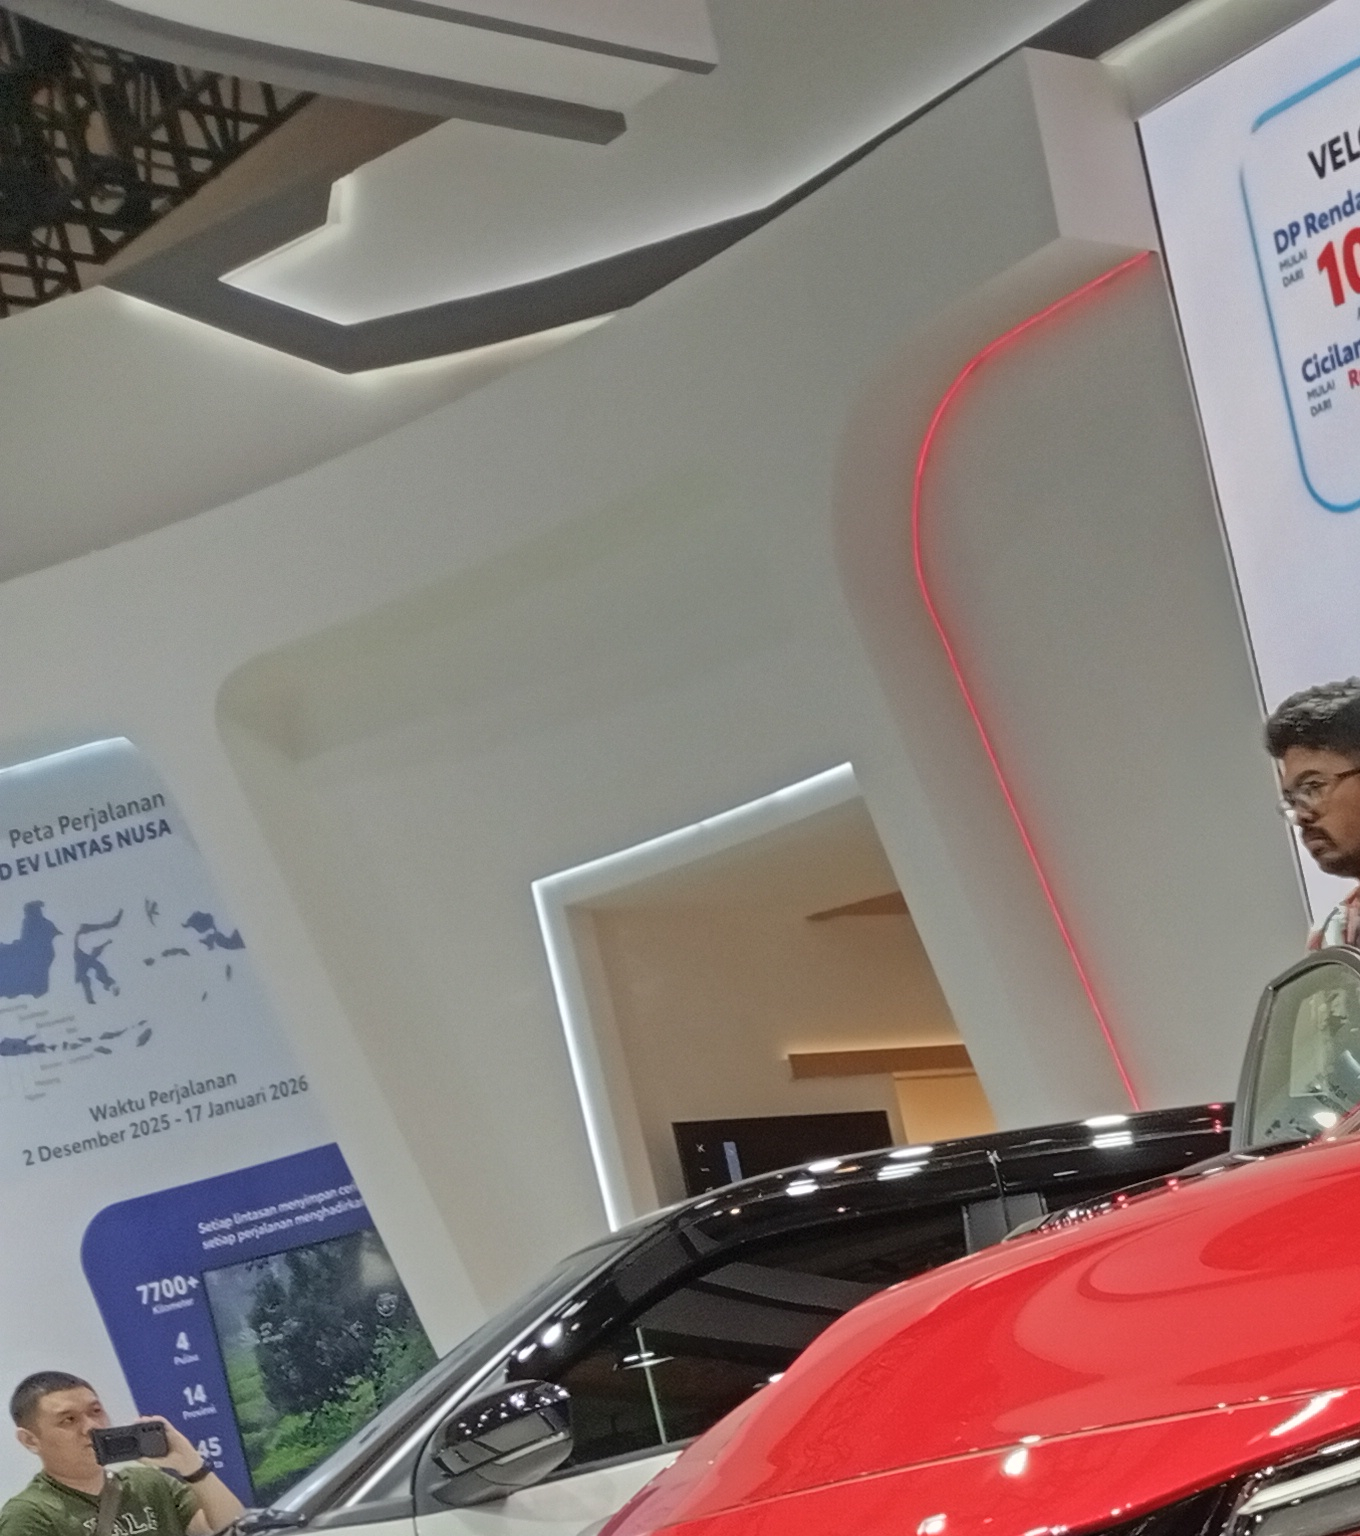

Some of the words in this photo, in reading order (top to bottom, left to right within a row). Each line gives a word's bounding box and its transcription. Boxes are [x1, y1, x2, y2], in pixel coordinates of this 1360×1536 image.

[1273, 220, 1301, 255] DP
[8, 823, 55, 850] Peta
[57, 792, 166, 837] Perjalanan
[16, 853, 39, 877] EV
[45, 834, 113, 869] LINTAS
[115, 819, 173, 849] NUSA
[88, 1097, 146, 1124] Waktu
[148, 1072, 238, 1110] Perjalanan
[22, 1149, 35, 1167] 2
[38, 1126, 127, 1163] Desember
[129, 1113, 172, 1140] 2025
[184, 1103, 202, 1125] 17
[206, 1085, 268, 1119] Januari
[269, 1074, 310, 1102] 2026
[135, 1274, 200, 1306] 7700+
[175, 1331, 191, 1351] 4
[183, 1384, 207, 1406] 14
